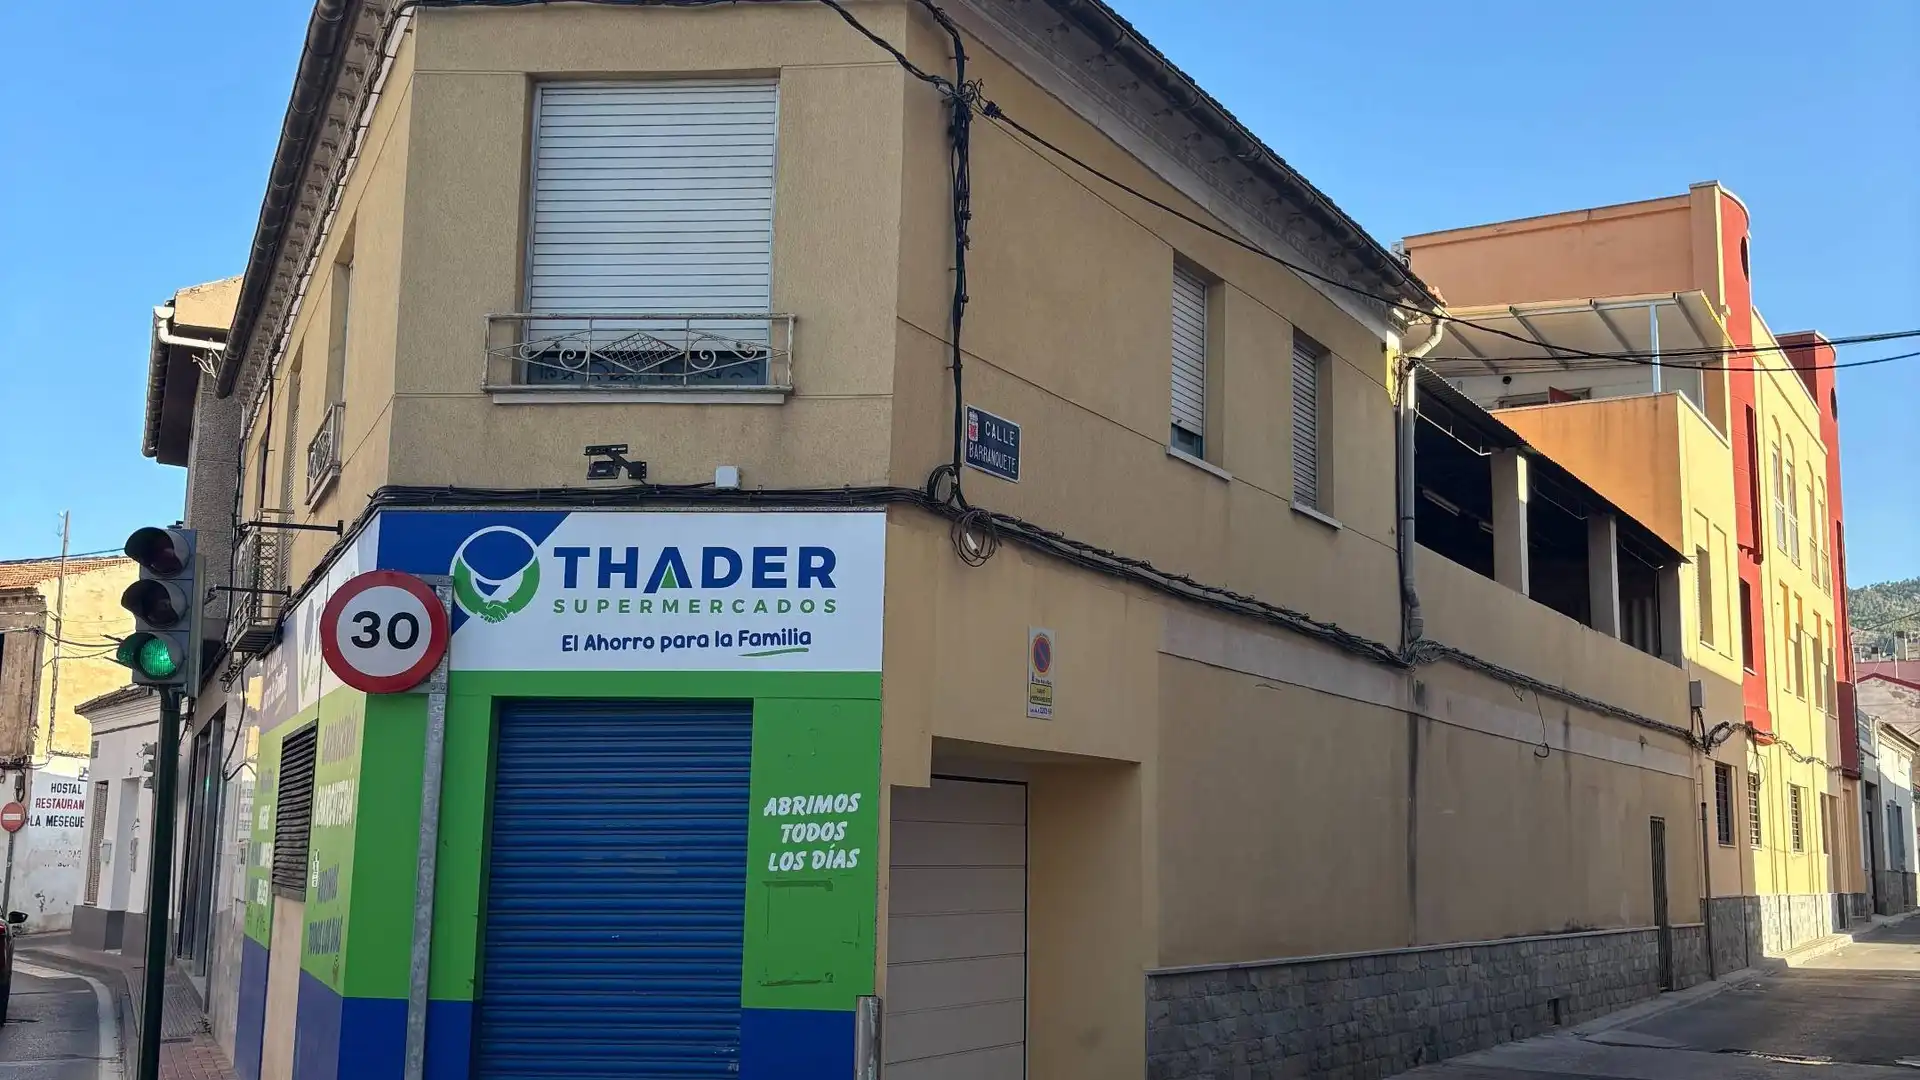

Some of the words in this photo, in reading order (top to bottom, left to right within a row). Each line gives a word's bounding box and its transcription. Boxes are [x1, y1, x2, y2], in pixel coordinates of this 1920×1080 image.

[985, 420, 1015, 447] CALLE
[969, 441, 1017, 474] BARRANQUETE
[553, 546, 837, 593] THADER
[552, 599, 837, 614] SUPERMERCADOS
[351, 610, 419, 650] 30
[562, 634, 579, 652] El
[584, 633, 655, 651] Ahorro
[660, 633, 709, 653] para
[715, 630, 733, 647] la
[738, 627, 812, 648] Familia
[50, 782, 82, 795] HOSTAL
[763, 792, 861, 817] ABRIMOS
[30, 814, 41, 827] LA
[781, 821, 848, 844] TODOS
[768, 851, 807, 872] LOS
[812, 843, 861, 870] DÍAS
